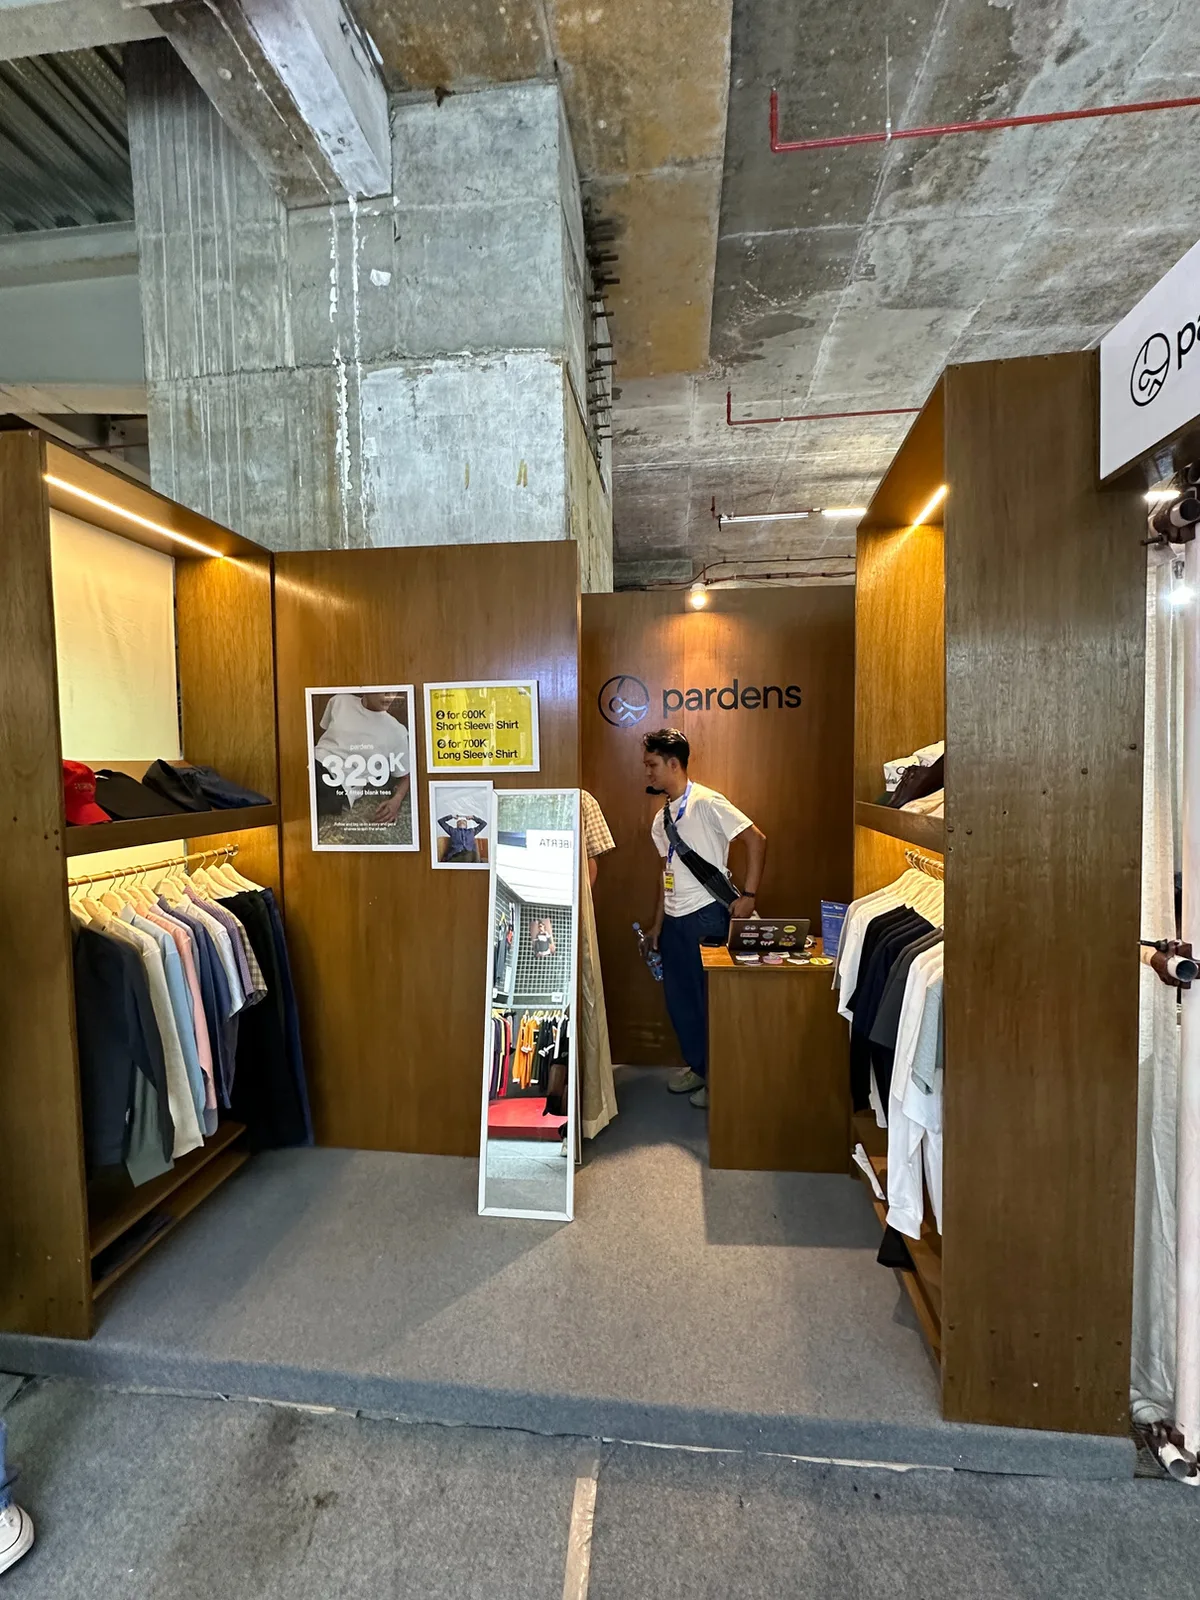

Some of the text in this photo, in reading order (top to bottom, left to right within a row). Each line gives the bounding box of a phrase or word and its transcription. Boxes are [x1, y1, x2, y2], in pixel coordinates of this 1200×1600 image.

[1177, 314, 1200, 370] p
[662, 678, 802, 719] pardens
[447, 710, 460, 719] for
[462, 710, 486, 719] 600K
[436, 720, 519, 731] Short Sleeve Shirt
[448, 739, 461, 748] for
[463, 739, 487, 748] 700K
[437, 749, 518, 761] Long Sleeve Shirt
[321, 752, 406, 787] 329K
